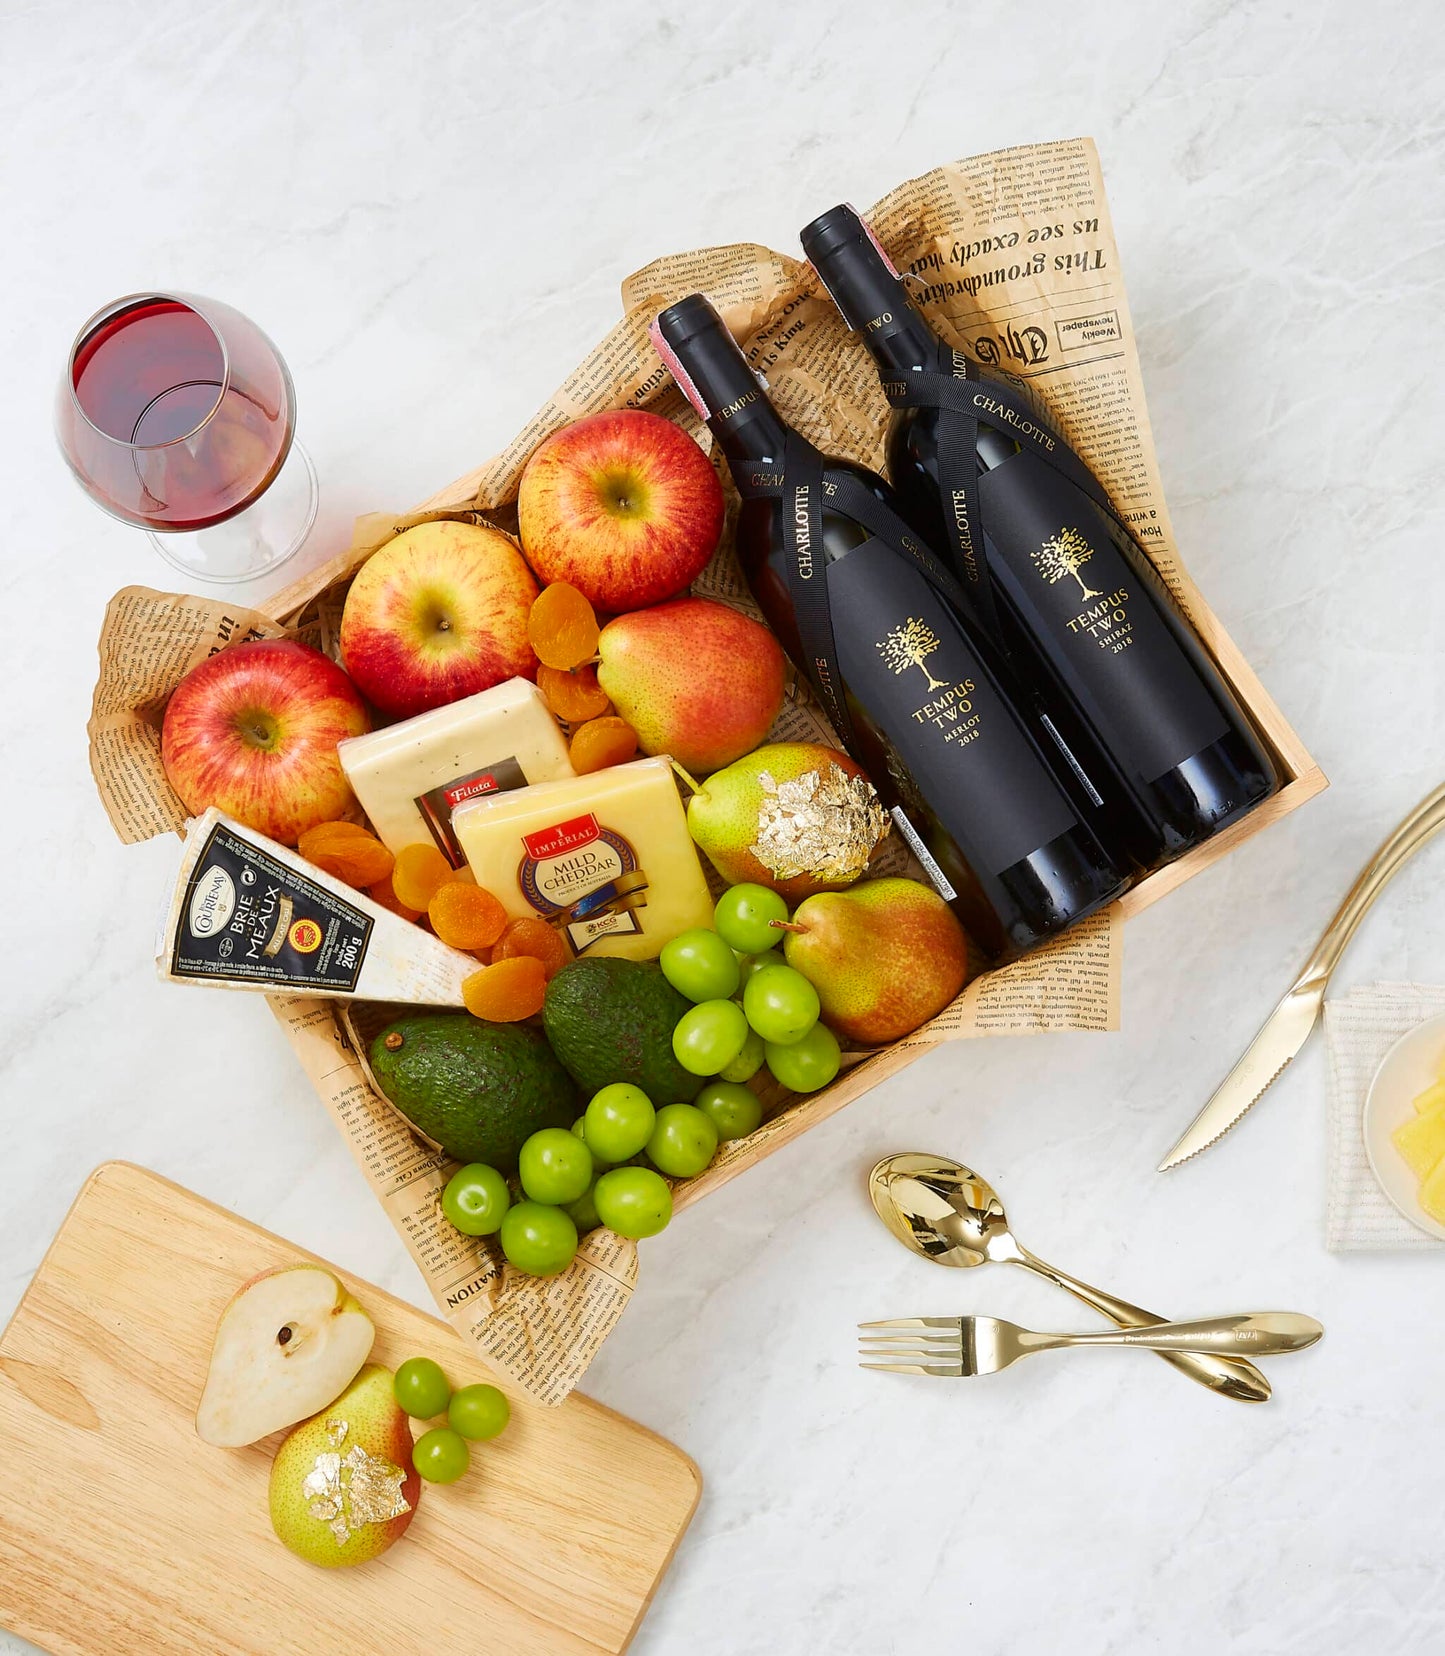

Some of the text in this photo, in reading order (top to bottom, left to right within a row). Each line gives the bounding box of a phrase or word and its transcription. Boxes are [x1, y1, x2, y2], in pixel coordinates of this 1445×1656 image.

[1025, 223, 1065, 245] see
[1071, 217, 1100, 236] us
[948, 231, 1020, 269] exactly
[1052, 248, 1106, 276] This
[744, 288, 811, 361] in New Orle
[866, 313, 893, 337] TWO
[1060, 315, 1114, 333] newspaper
[1080, 325, 1115, 340] Weekly
[762, 317, 805, 366] Is King
[715, 389, 761, 422] TEMPUS
[971, 392, 1056, 452] CHARLOTTE
[1149, 509, 1156, 518] a
[795, 485, 813, 578] CHARLOTTE
[952, 488, 978, 581] CHARLOTTE
[1139, 524, 1161, 539] How
[1065, 587, 1129, 635] TEMPUS
[1086, 607, 1127, 639] TWO
[216, 615, 240, 642] in
[1097, 622, 1132, 648] SHIRAZ
[1111, 636, 1133, 653] 2018
[911, 677, 976, 725] TEMPUS
[931, 697, 973, 730] TWO
[943, 714, 981, 742] MERLOT
[957, 728, 980, 746] 2018
[450, 780, 490, 801] Filata
[535, 827, 592, 855] IMPERIAL
[543, 856, 615, 892] CHEDDAR
[552, 850, 596, 876] MILD
[230, 893, 254, 933] BRIE
[245, 908, 260, 926] DE
[245, 884, 279, 958] MEAUX
[596, 916, 616, 928] KCG
[341, 944, 357, 969] 200
[351, 936, 362, 945] g
[1026, 1020, 1049, 1028] popular
[1067, 1022, 1106, 1031] Strawberries
[394, 1158, 433, 1185] Down Cake
[516, 1294, 583, 1383] When choosing which type of pasta
[523, 1293, 595, 1389] Pasta sauces vary in taste, color and
